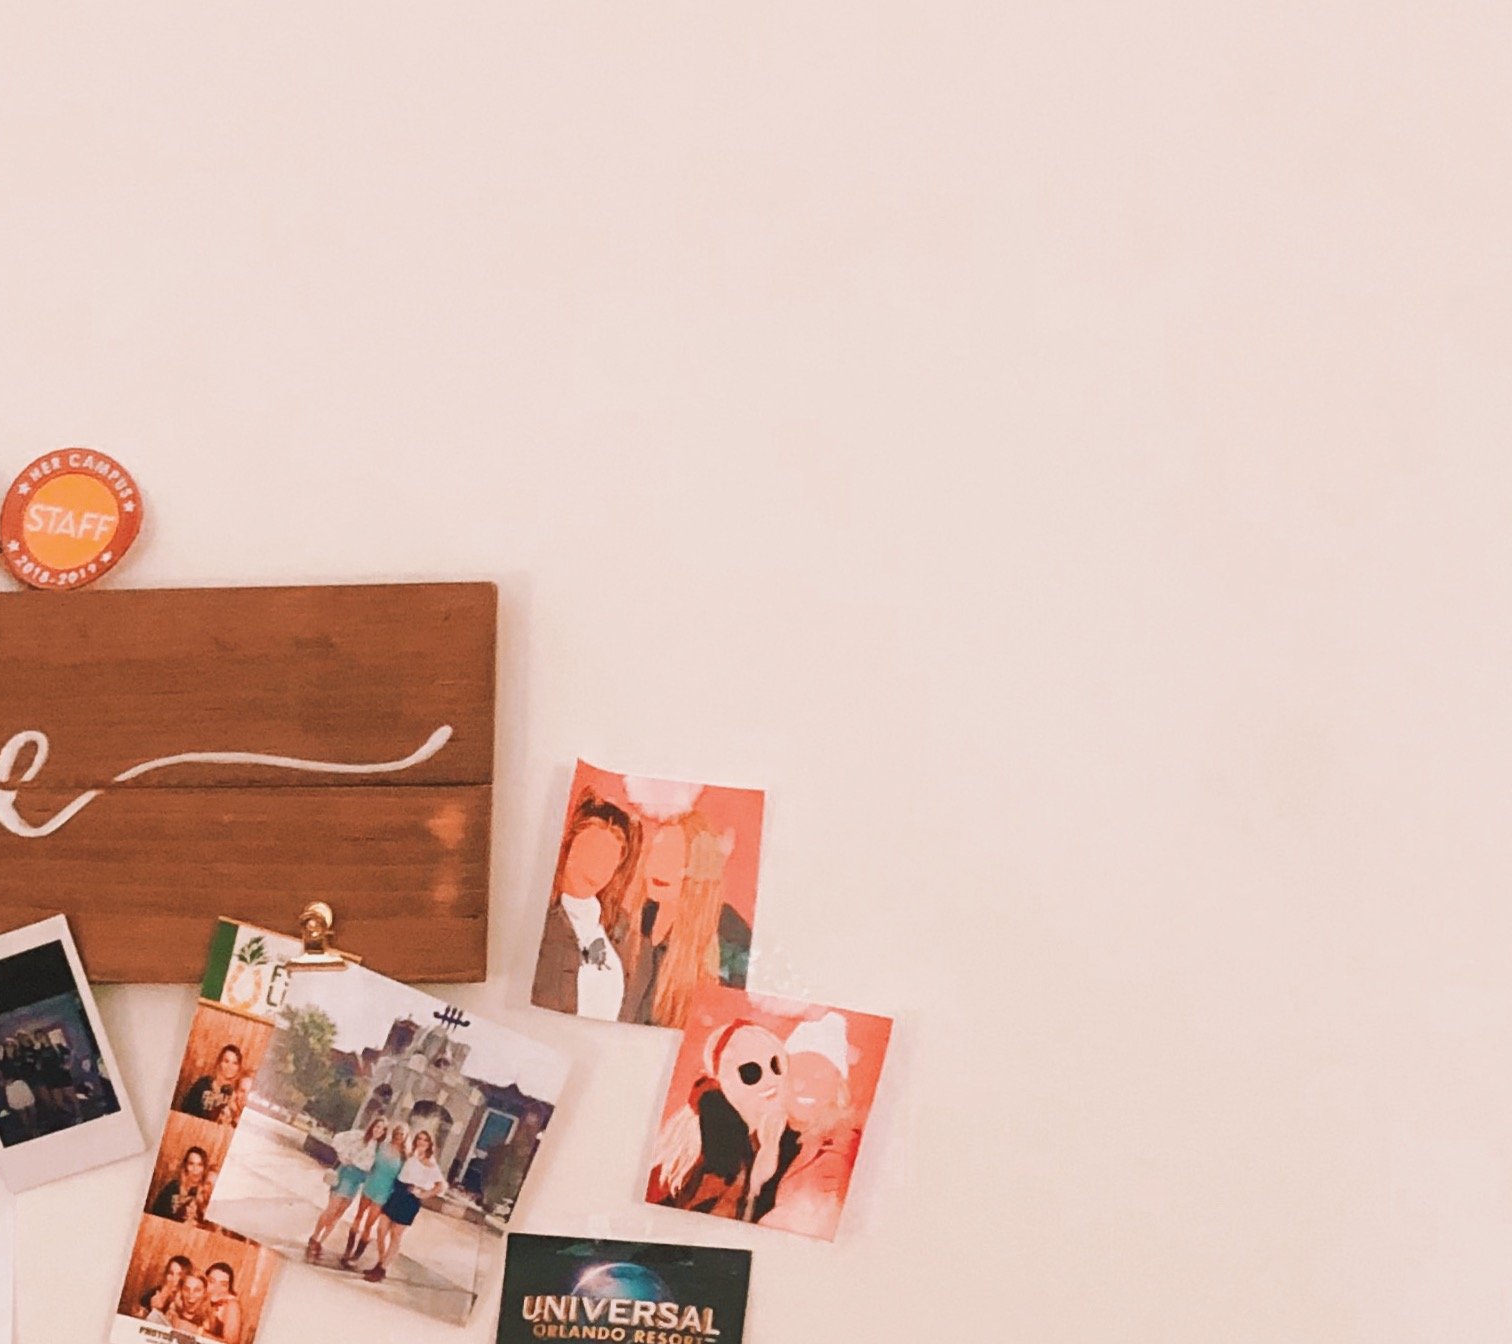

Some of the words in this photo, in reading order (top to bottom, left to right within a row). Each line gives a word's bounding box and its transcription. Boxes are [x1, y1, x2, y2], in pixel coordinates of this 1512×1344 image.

[29, 457, 63, 481] HER
[67, 452, 134, 500] CAMPUS
[25, 503, 117, 542] STAFF
[14, 554, 98, 585] 2018-2019
[522, 1295, 721, 1336] UNIVERSAL
[532, 1324, 626, 1342] ORLANDO
